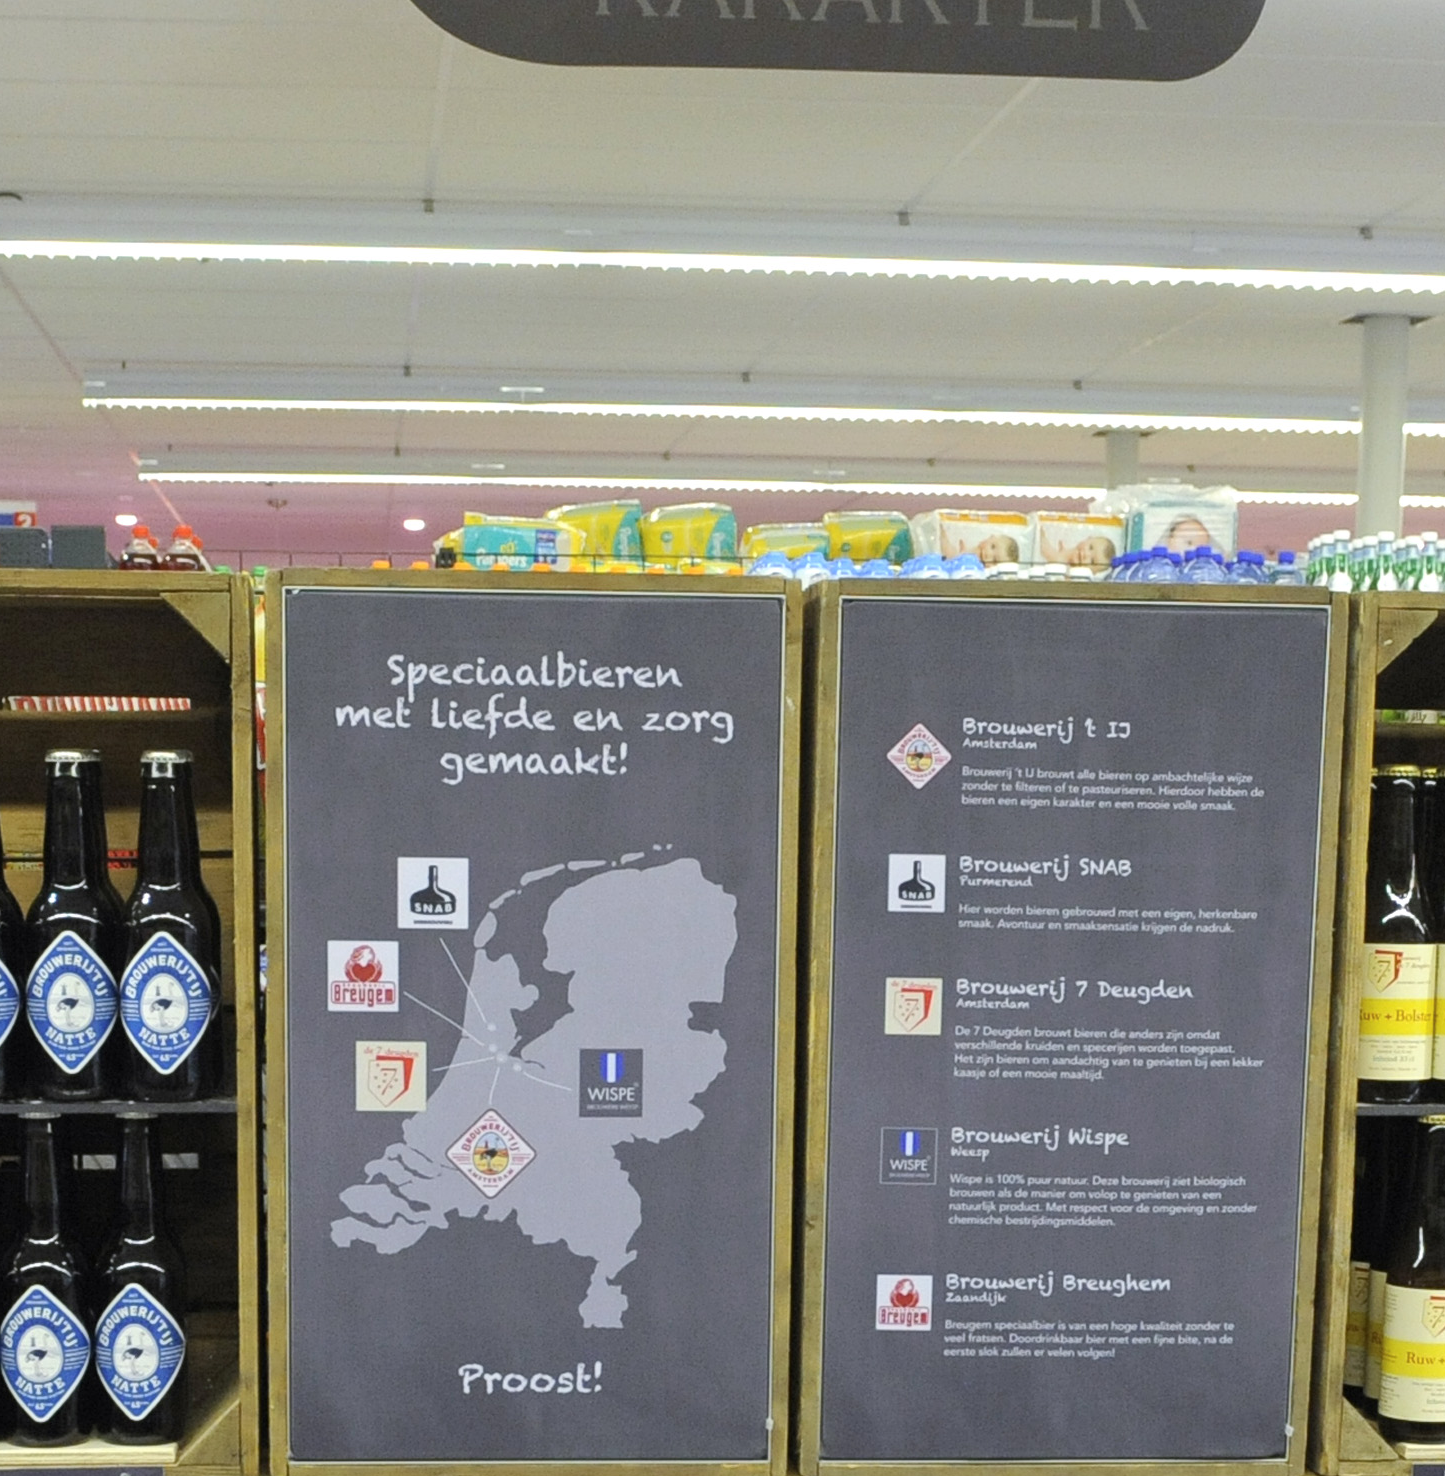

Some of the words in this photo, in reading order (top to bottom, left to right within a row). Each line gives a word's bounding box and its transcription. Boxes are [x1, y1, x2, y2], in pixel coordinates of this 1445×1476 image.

[386, 650, 682, 702] Speciaalbieren
[335, 698, 411, 729] met
[431, 694, 555, 738] liefde
[573, 707, 623, 732] en
[641, 707, 735, 743] zorg
[962, 717, 1075, 744] Brouwerij
[962, 738, 1037, 750] Amsterdam
[440, 742, 629, 785] gemaakt!
[962, 766, 1012, 780] Brouwerij
[1037, 768, 1074, 779] brouwt
[1077, 769, 1096, 780] alle
[1098, 769, 1132, 781] bieren
[1135, 774, 1149, 784] op
[1151, 771, 1225, 785] ambachtelijke
[1227, 773, 1253, 785] wijze
[962, 780, 998, 791] zonder
[1001, 782, 1013, 791] te
[1015, 781, 1052, 793] filteren
[1054, 782, 1066, 793] of
[1068, 784, 1080, 794] te
[1158, 785, 1205, 796] Hierdoor
[1207, 786, 1248, 797] hebben
[1250, 787, 1265, 798] de
[959, 854, 1070, 883] Brouwerij
[1079, 857, 1132, 877] SNAB
[959, 875, 1033, 888] Purmerend
[414, 902, 453, 913] SNAB
[334, 984, 393, 1007] Breugem
[956, 977, 1066, 1003] Brouwerij
[1075, 982, 1086, 998] 7
[1098, 980, 1194, 1004] Deugden
[956, 998, 1030, 1010] Amsterdam
[45, 1028, 97, 1047] NATTE
[587, 1087, 635, 1101] WISPE
[951, 1125, 1060, 1151] Brouwerij
[1069, 1127, 1130, 1155] Wispe
[951, 1147, 990, 1162] Weesp
[889, 1158, 928, 1171] WISPE
[950, 1173, 983, 1186] Wispe
[985, 1174, 994, 1185] is
[997, 1174, 1025, 1185] 100%
[1027, 1176, 1051, 1187] puur
[1092, 1176, 1119, 1187] Deze
[1121, 1175, 1170, 1188] brouwerij
[1172, 1176, 1191, 1187] ziet
[1193, 1176, 1246, 1188] biologisch
[945, 1271, 1054, 1297] Brouwerij
[1063, 1274, 1171, 1298] Breughem
[945, 1291, 1007, 1306] Zaandijk
[879, 1309, 929, 1327] Breugem
[458, 1362, 603, 1395] Proost!
